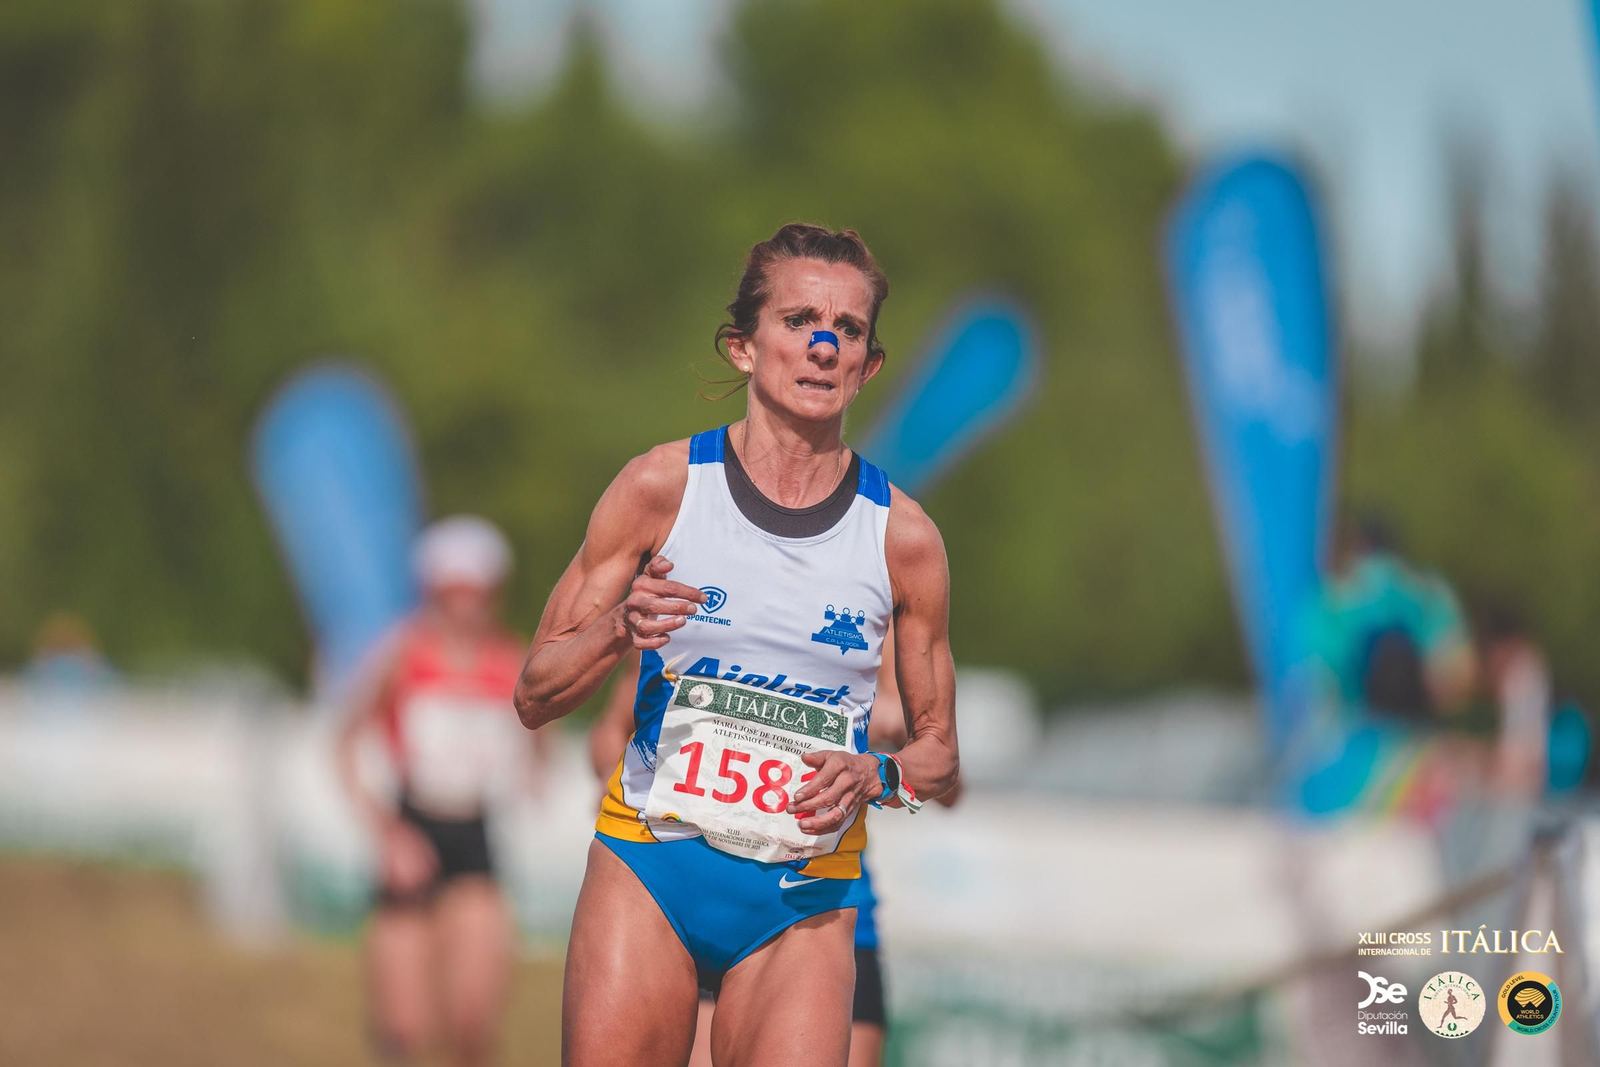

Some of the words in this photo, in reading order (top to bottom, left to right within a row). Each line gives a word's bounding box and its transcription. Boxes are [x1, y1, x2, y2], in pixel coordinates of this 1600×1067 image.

[824, 629, 863, 640] ATLETISMO
[725, 692, 808, 728] ITÁLICA
[712, 719, 738, 730] MARÍA
[772, 734, 793, 745] TORO
[794, 740, 812, 749] SAIZ
[713, 728, 757, 743] ATLETISMO
[758, 739, 772, 747] C.P.
[773, 742, 783, 751] LA
